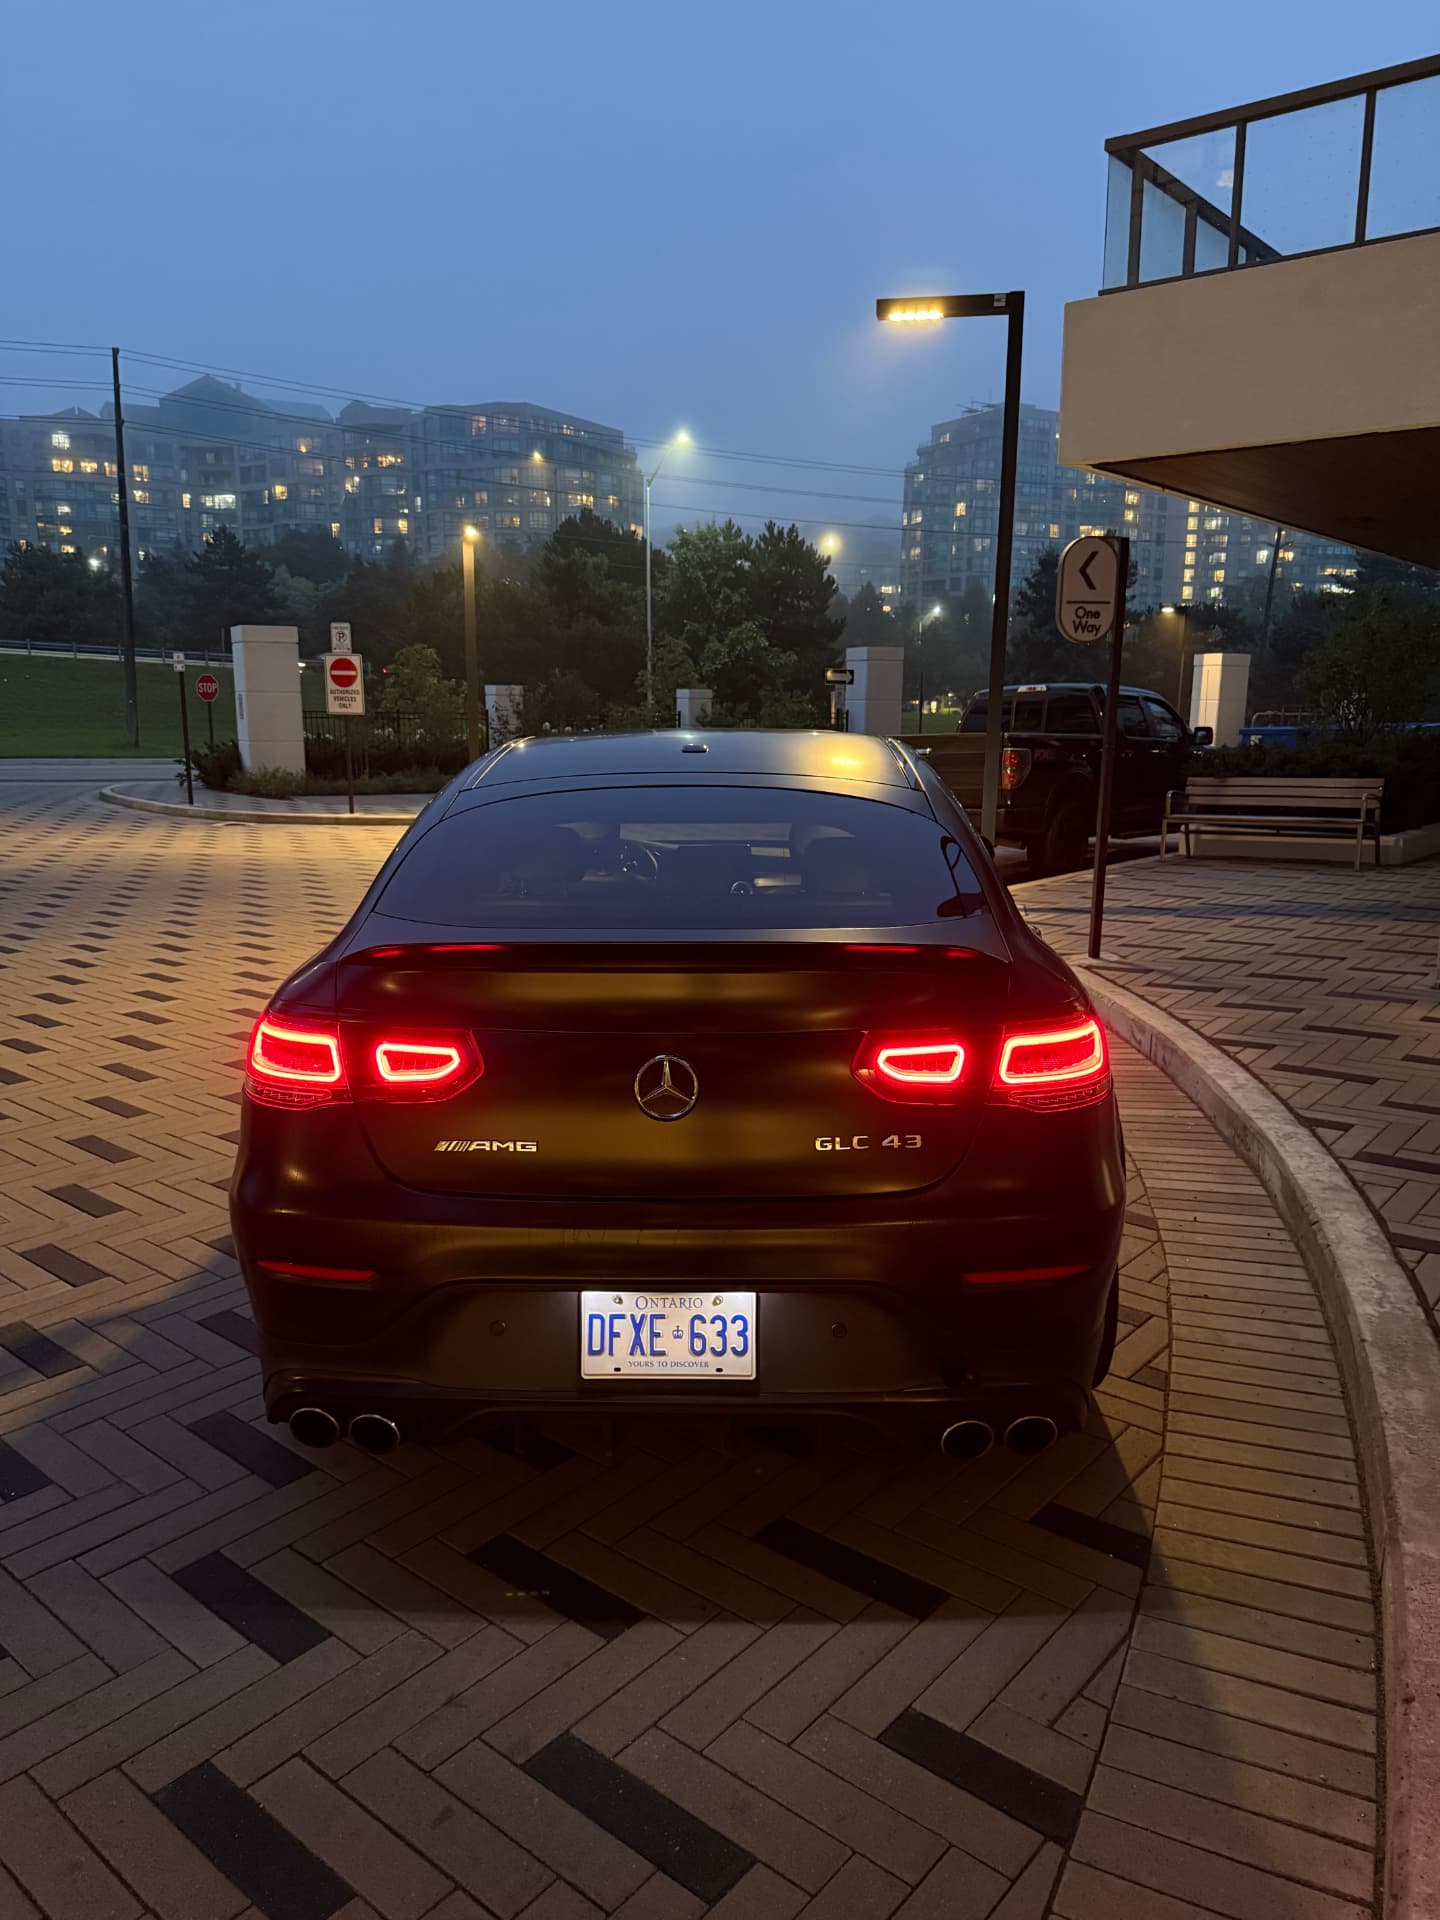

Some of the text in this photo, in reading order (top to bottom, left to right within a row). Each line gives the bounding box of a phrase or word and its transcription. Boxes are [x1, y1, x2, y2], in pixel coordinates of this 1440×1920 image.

[1075, 606, 1101, 619] One
[1072, 620, 1102, 636] Way
[198, 682, 217, 693] STOP
[467, 1140, 537, 1152] AMG
[815, 1134, 922, 1151] GLC 43
[635, 1295, 703, 1310] ONTARIO
[587, 1313, 749, 1357] DFXE 633
